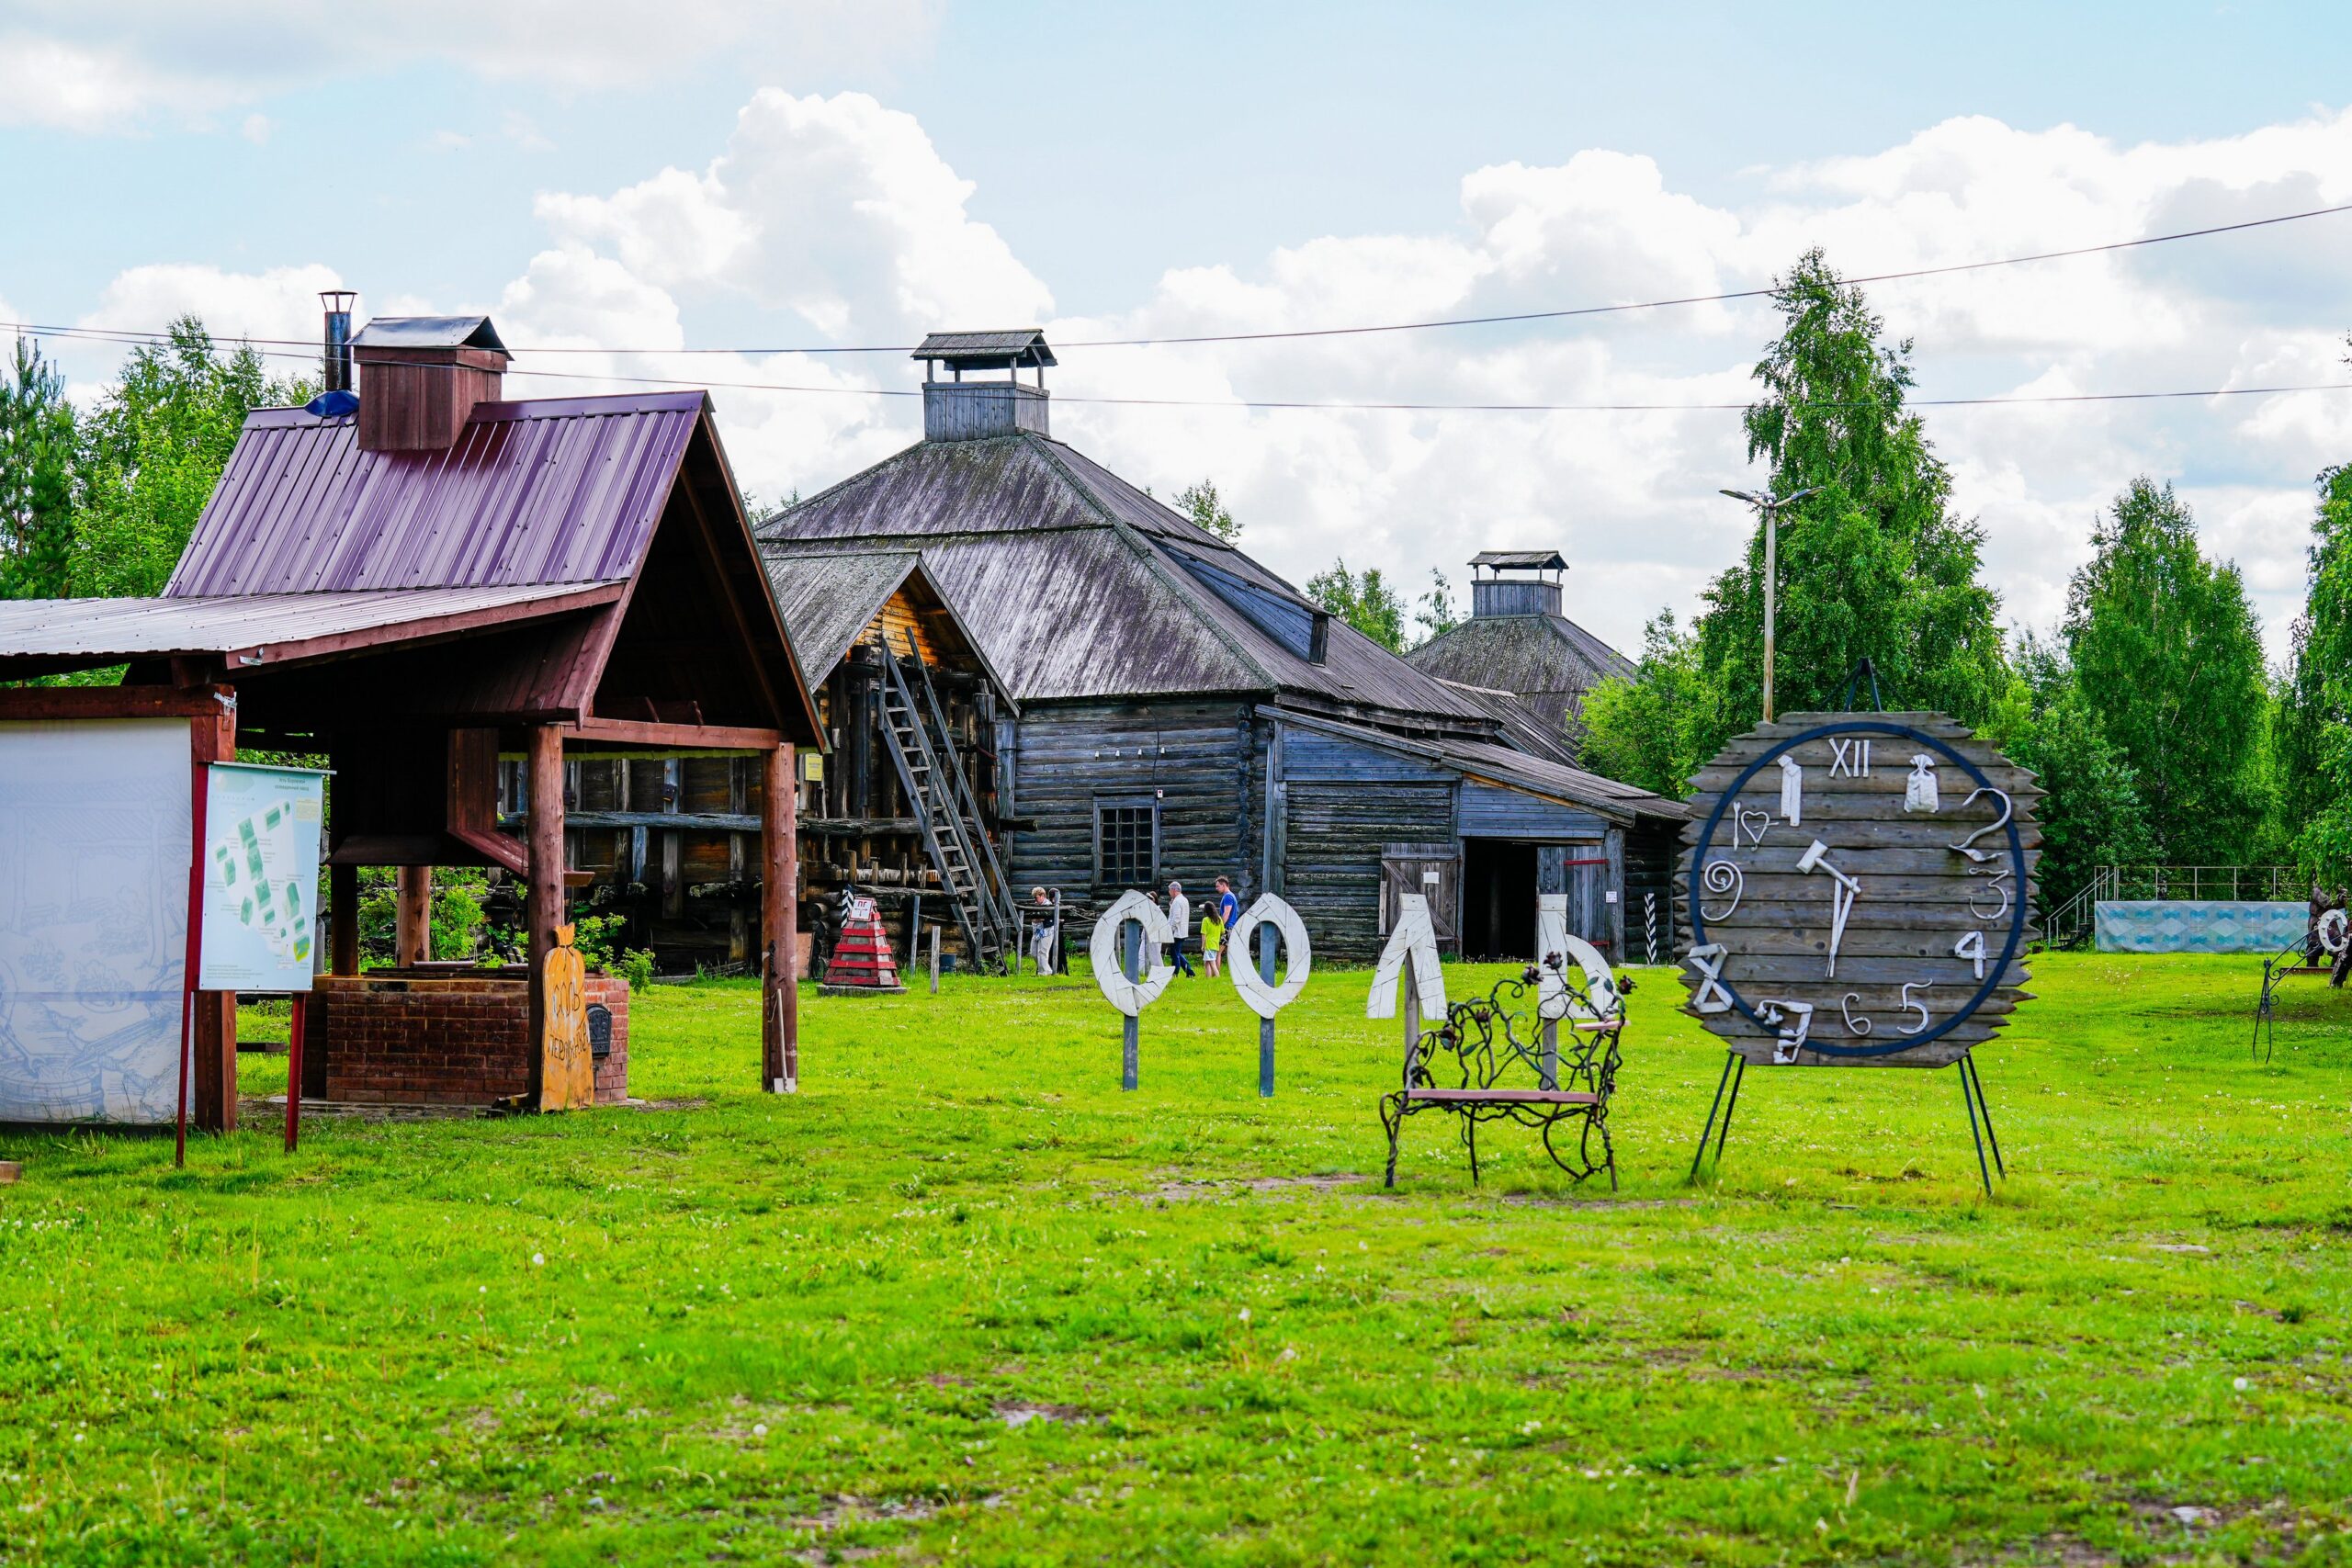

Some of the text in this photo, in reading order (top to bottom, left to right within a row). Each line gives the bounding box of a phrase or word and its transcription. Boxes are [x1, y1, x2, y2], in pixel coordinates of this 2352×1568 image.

[1827, 738, 1870, 778] XII
[1949, 787, 2012, 863] 2
[1701, 860, 1743, 921] 9
[1968, 867, 2009, 919] 3
[1688, 942, 1735, 1013] 8
[1954, 931, 1986, 980] 4
[1753, 999, 1814, 1065] 7
[1841, 992, 1871, 1036] 6
[1896, 977, 1933, 1034] 5
